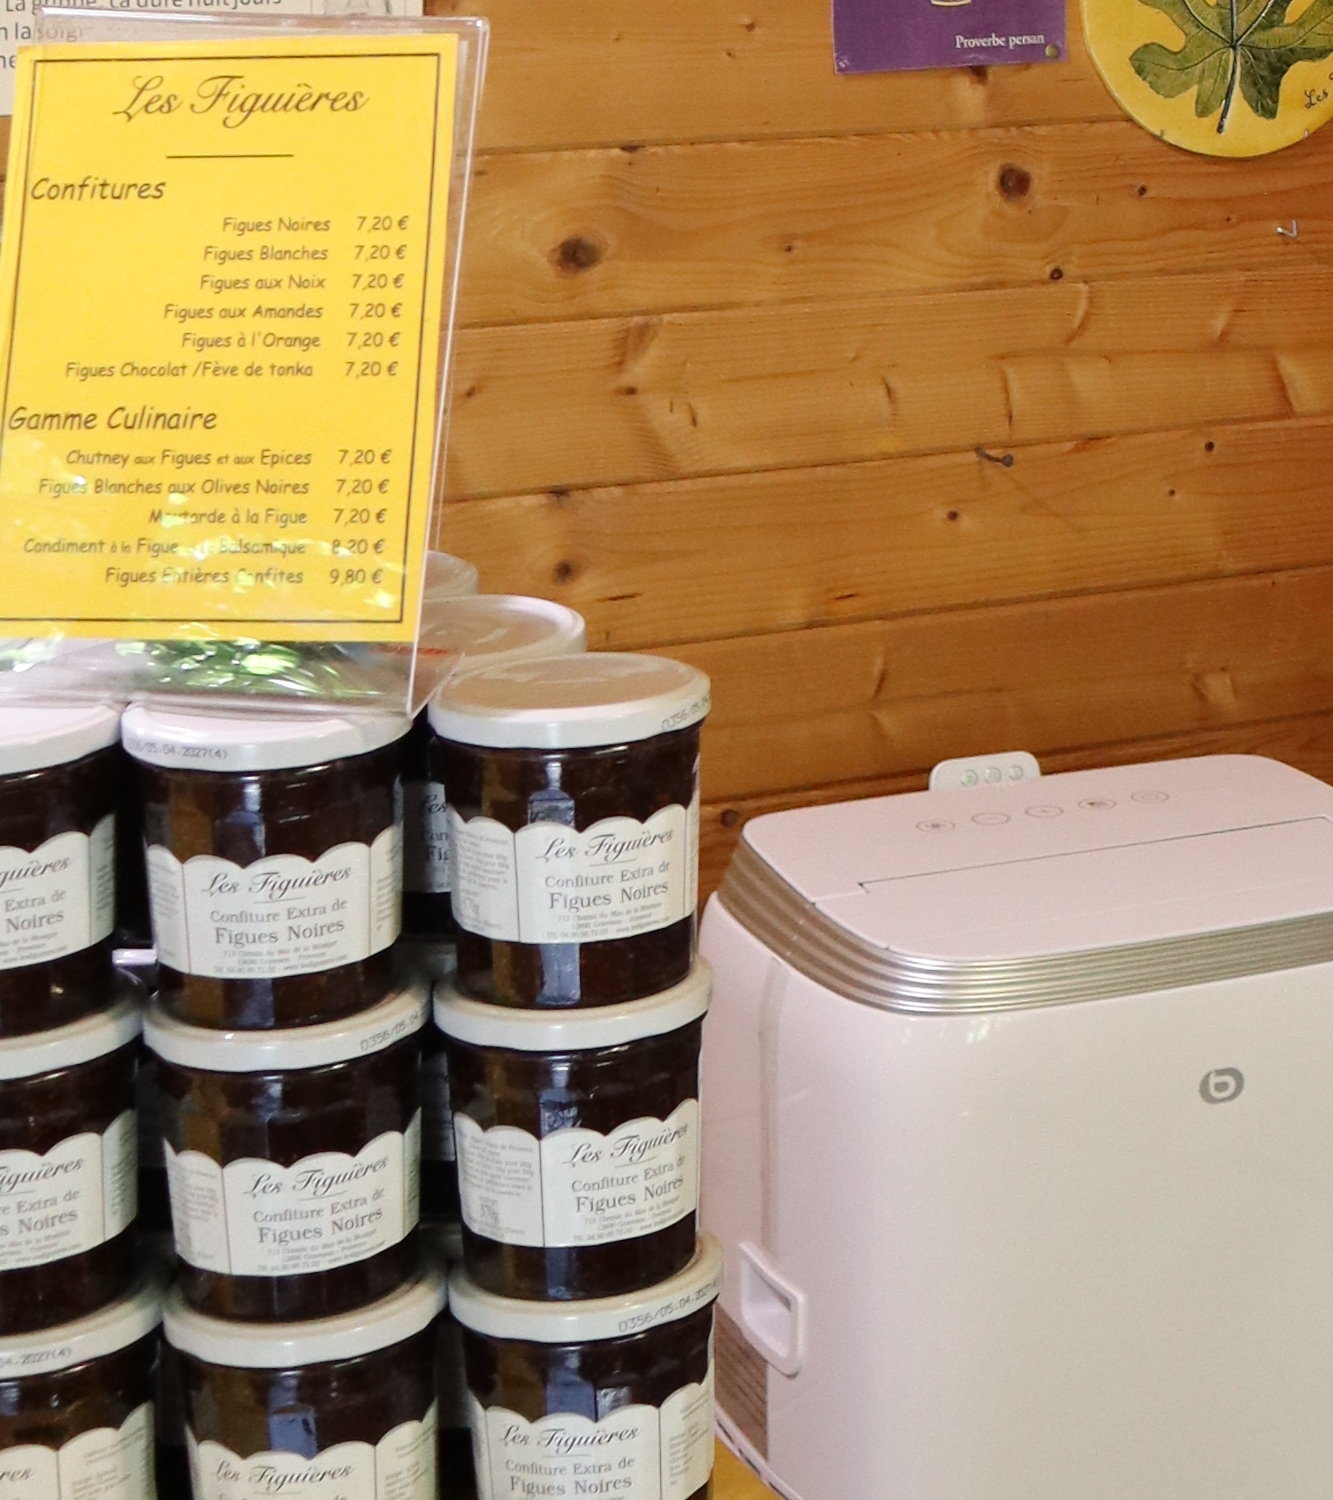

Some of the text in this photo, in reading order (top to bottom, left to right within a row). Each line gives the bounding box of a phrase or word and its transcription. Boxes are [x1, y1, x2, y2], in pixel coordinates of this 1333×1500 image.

[955, 33, 1044, 50] Proverbe persan
[112, 75, 369, 128] Les Figuières
[31, 173, 166, 202] Confitures
[222, 215, 409, 236] Figues Noires 7,20 €
[204, 244, 407, 265] Figues Blanches 7,20 €
[200, 273, 405, 294] Figues aux Noix 7,20 €
[164, 303, 403, 323] Figues aux Amandes 7,20 €
[182, 333, 232, 352] Figues
[237, 332, 246, 347] à
[347, 332, 383, 349] 7,20
[388, 332, 401, 347] €
[66, 362, 115, 382] Figues
[121, 362, 187, 377] Chocolat
[244, 362, 263, 376] de
[269, 362, 313, 376] tonka
[345, 361, 381, 378] 7,20
[387, 361, 398, 376] €
[8, 405, 217, 431] Gamme Culinaire
[66, 449, 392, 469] Chutney aux Figues et aux Epices 7,20 €
[39, 478, 390, 498] Figues Blanches aux Olives Noires 7,20 €
[535, 829, 673, 862] Les Figuières
[202, 866, 353, 900] Les Figuières
[211, 899, 348, 924] Confiture Extra de
[215, 919, 345, 948] Figues Noires
